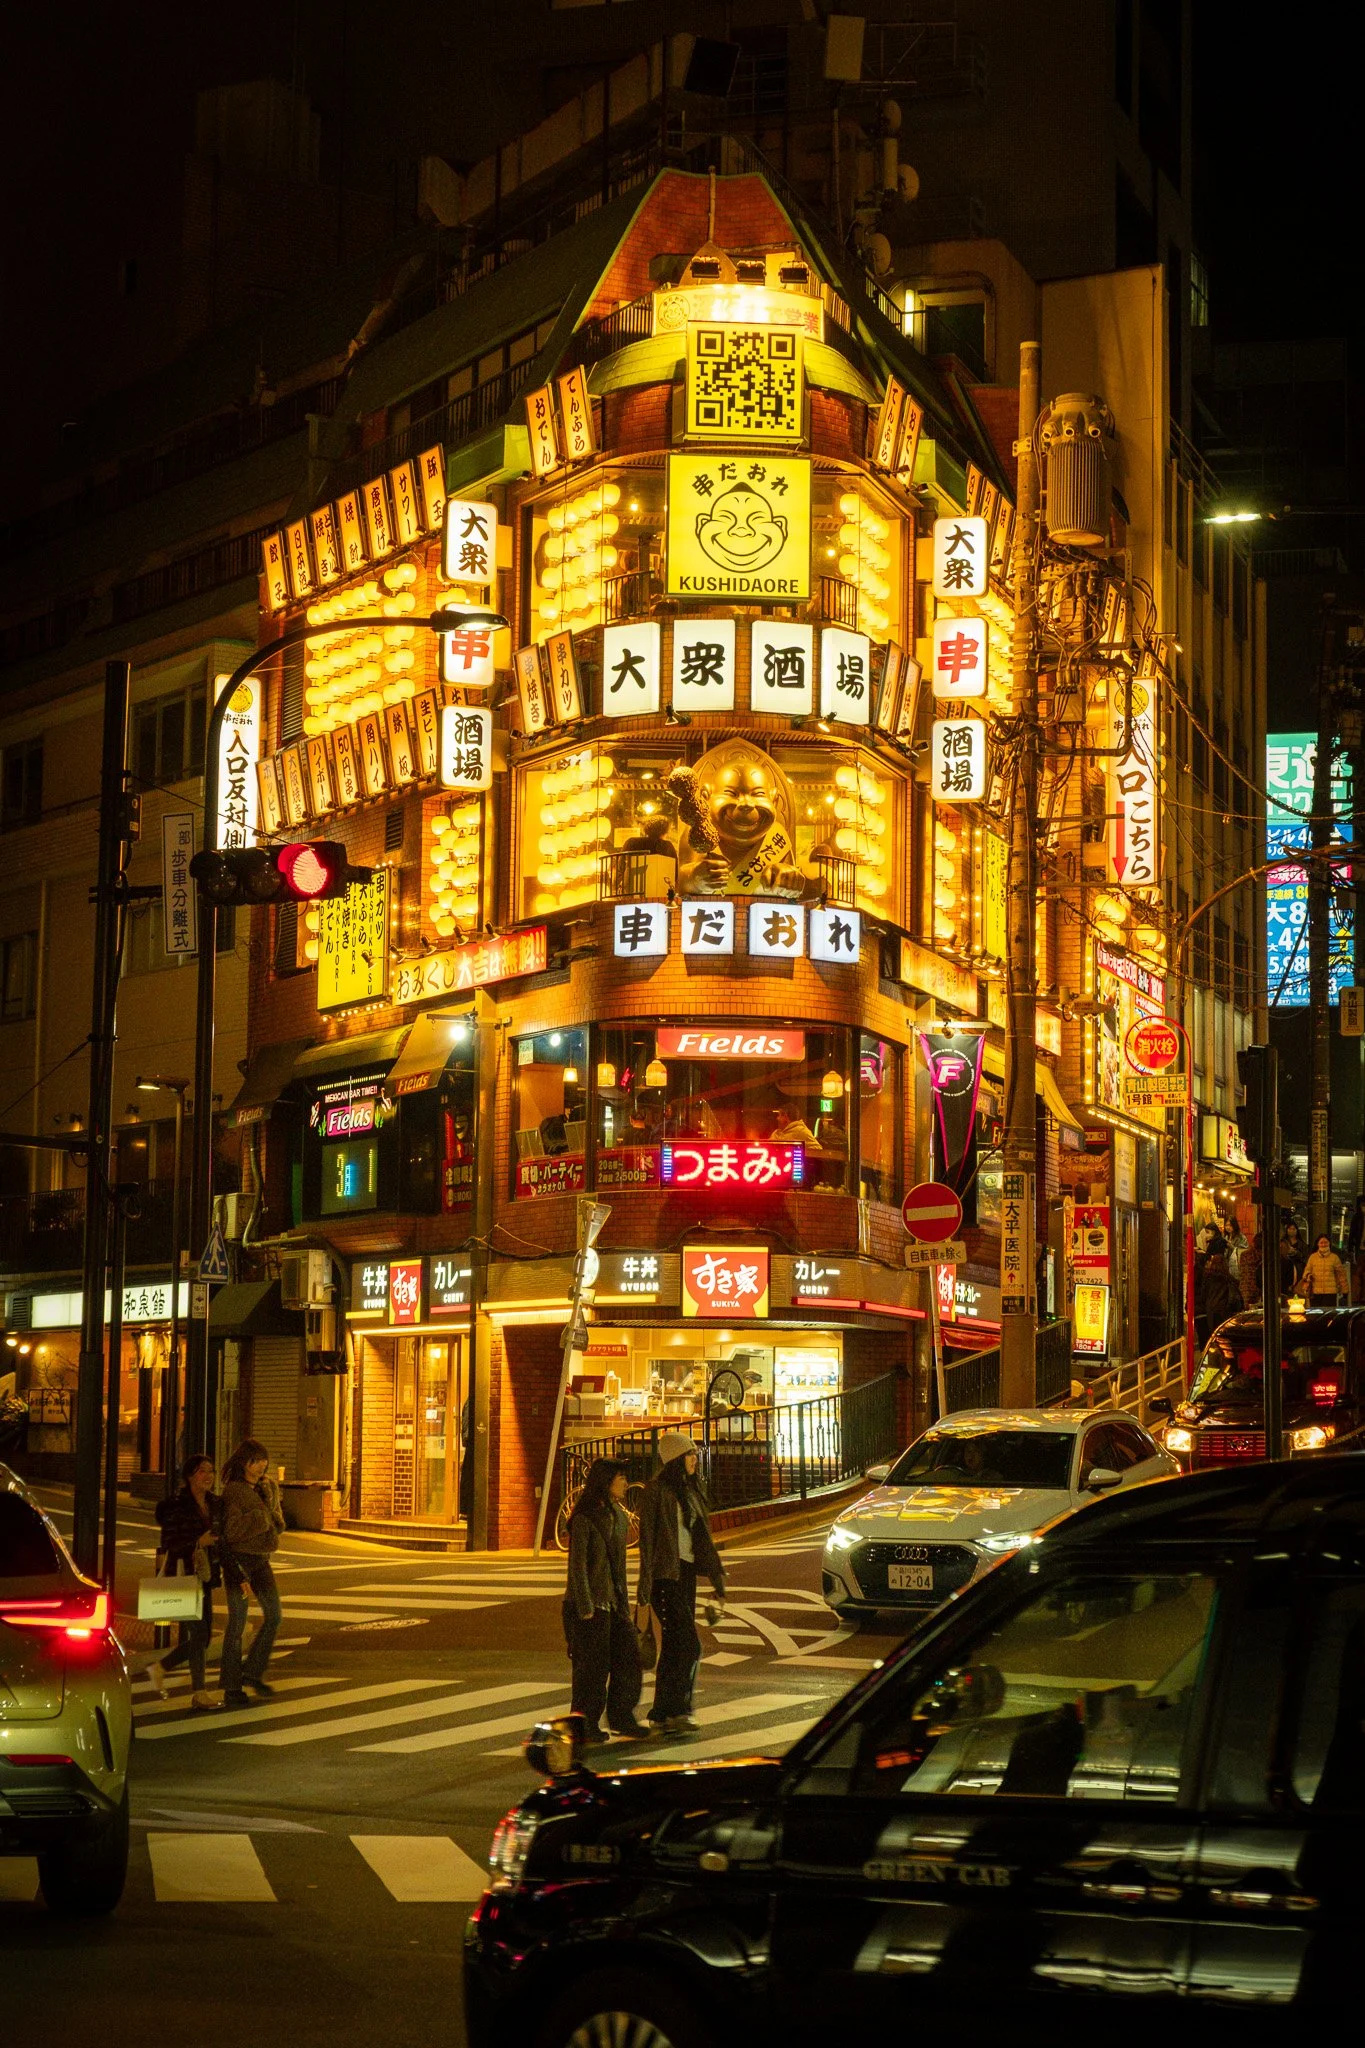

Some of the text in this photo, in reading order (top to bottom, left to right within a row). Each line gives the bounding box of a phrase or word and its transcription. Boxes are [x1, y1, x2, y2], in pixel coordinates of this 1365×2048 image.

[535, 398, 551, 467] おでん
[566, 375, 585, 452] てんぷら
[692, 462, 789, 498] 串だおれ
[371, 487, 386, 551] 唐揚げ
[399, 473, 412, 535] サワー
[459, 508, 489, 582] 大衆
[943, 524, 975, 589] 大衆
[679, 575, 799, 594] KUSHIDAORE
[451, 630, 490, 670] 串
[611, 641, 865, 700] 大衆酒場
[937, 632, 979, 684] 串
[525, 655, 539, 724] 串焼き
[556, 641, 573, 712] 串カツ
[420, 700, 436, 769] 生ビール
[453, 712, 484, 782] 酒場
[1113, 719, 1150, 732] 串おれ
[313, 743, 328, 809] ハイボール
[338, 735, 354, 796] 50円串
[365, 723, 380, 787] 角ハイ
[941, 726, 974, 792] 酒場
[224, 729, 250, 849] 入口反対側
[263, 763, 276, 827] ホッピー
[737, 832, 787, 887] 串だおれ
[171, 848, 189, 949] 歩車分離式
[375, 874, 385, 940] 串カツ
[367, 880, 375, 995] USHIKASU
[620, 906, 856, 952] 串だおれ
[397, 958, 455, 1000] おみくじ
[677, 1033, 785, 1055] Fields
[1137, 1037, 1174, 1055] 消火栓
[398, 1075, 429, 1091] Fields
[1127, 1094, 1152, 1105] 1号館
[328, 1108, 371, 1132] Fields
[911, 1247, 962, 1263] 自転車を除く
[1005, 1201, 1020, 1271] 大平医院
[362, 1265, 388, 1295] 牛丼
[393, 1268, 417, 1307] すき家
[434, 1261, 472, 1290] カレー
[620, 1282, 660, 1292] GYUDON
[622, 1256, 658, 1279] 牛丼
[691, 1253, 759, 1299] すき家
[795, 1260, 840, 1281] カレー
[800, 1285, 830, 1295] CURRY
[124, 1288, 166, 1320] 和泉鮨
[711, 1300, 740, 1308] SUKIYA
[899, 1575, 930, 1588] 12-04
[863, 1861, 1012, 1887] GREEN CAB
